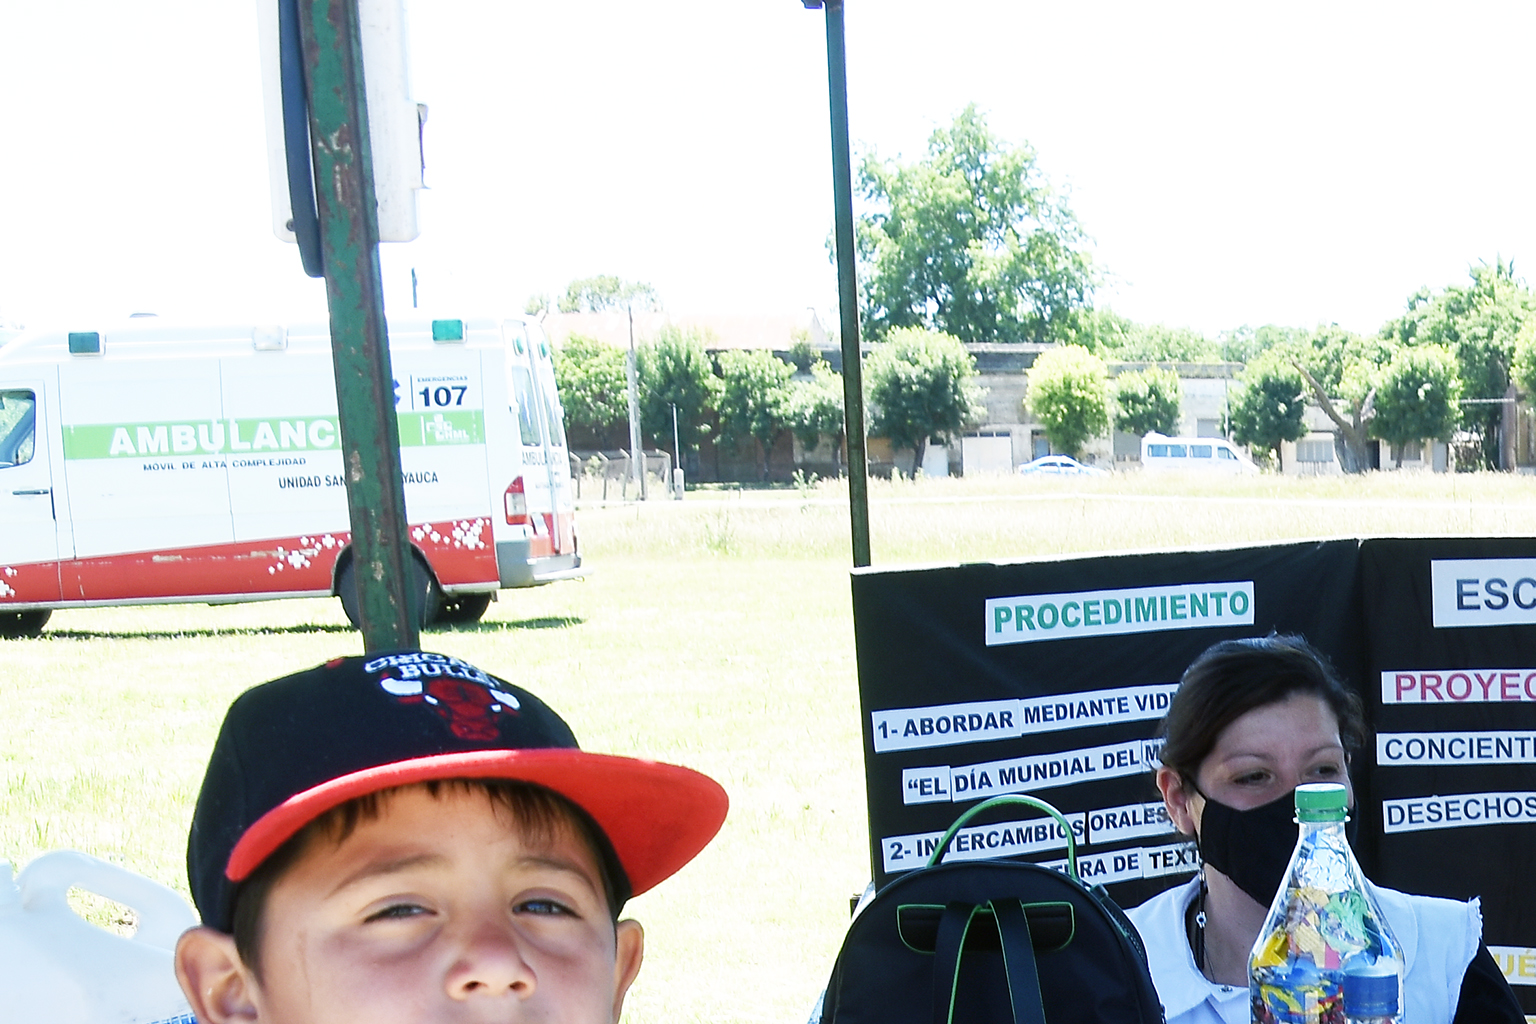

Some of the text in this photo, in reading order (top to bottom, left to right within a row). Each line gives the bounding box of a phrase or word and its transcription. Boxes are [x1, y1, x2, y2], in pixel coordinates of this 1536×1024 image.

[419, 385, 468, 407] 107
[110, 419, 336, 456] AMBULANC
[182, 461, 196, 470] DE
[201, 460, 227, 469] ALTA
[232, 457, 307, 468] COMPLEJIDAD
[278, 471, 439, 489] UNIDAD SAN YAUCA
[994, 590, 1249, 633] PROCEDIMIENTO
[903, 710, 1014, 738] ABORDAR
[1024, 696, 1130, 725] MEDIANTE
[1135, 691, 1177, 712] VID
[955, 768, 993, 793] DÍA
[1000, 756, 1096, 787] MUNDIAL
[1102, 749, 1140, 770] DEL
[916, 819, 1084, 857] INERCAMBIOS
[1113, 853, 1139, 873] DE
[1149, 848, 1200, 870] TEXT
[1494, 947, 1536, 978] UÉ
